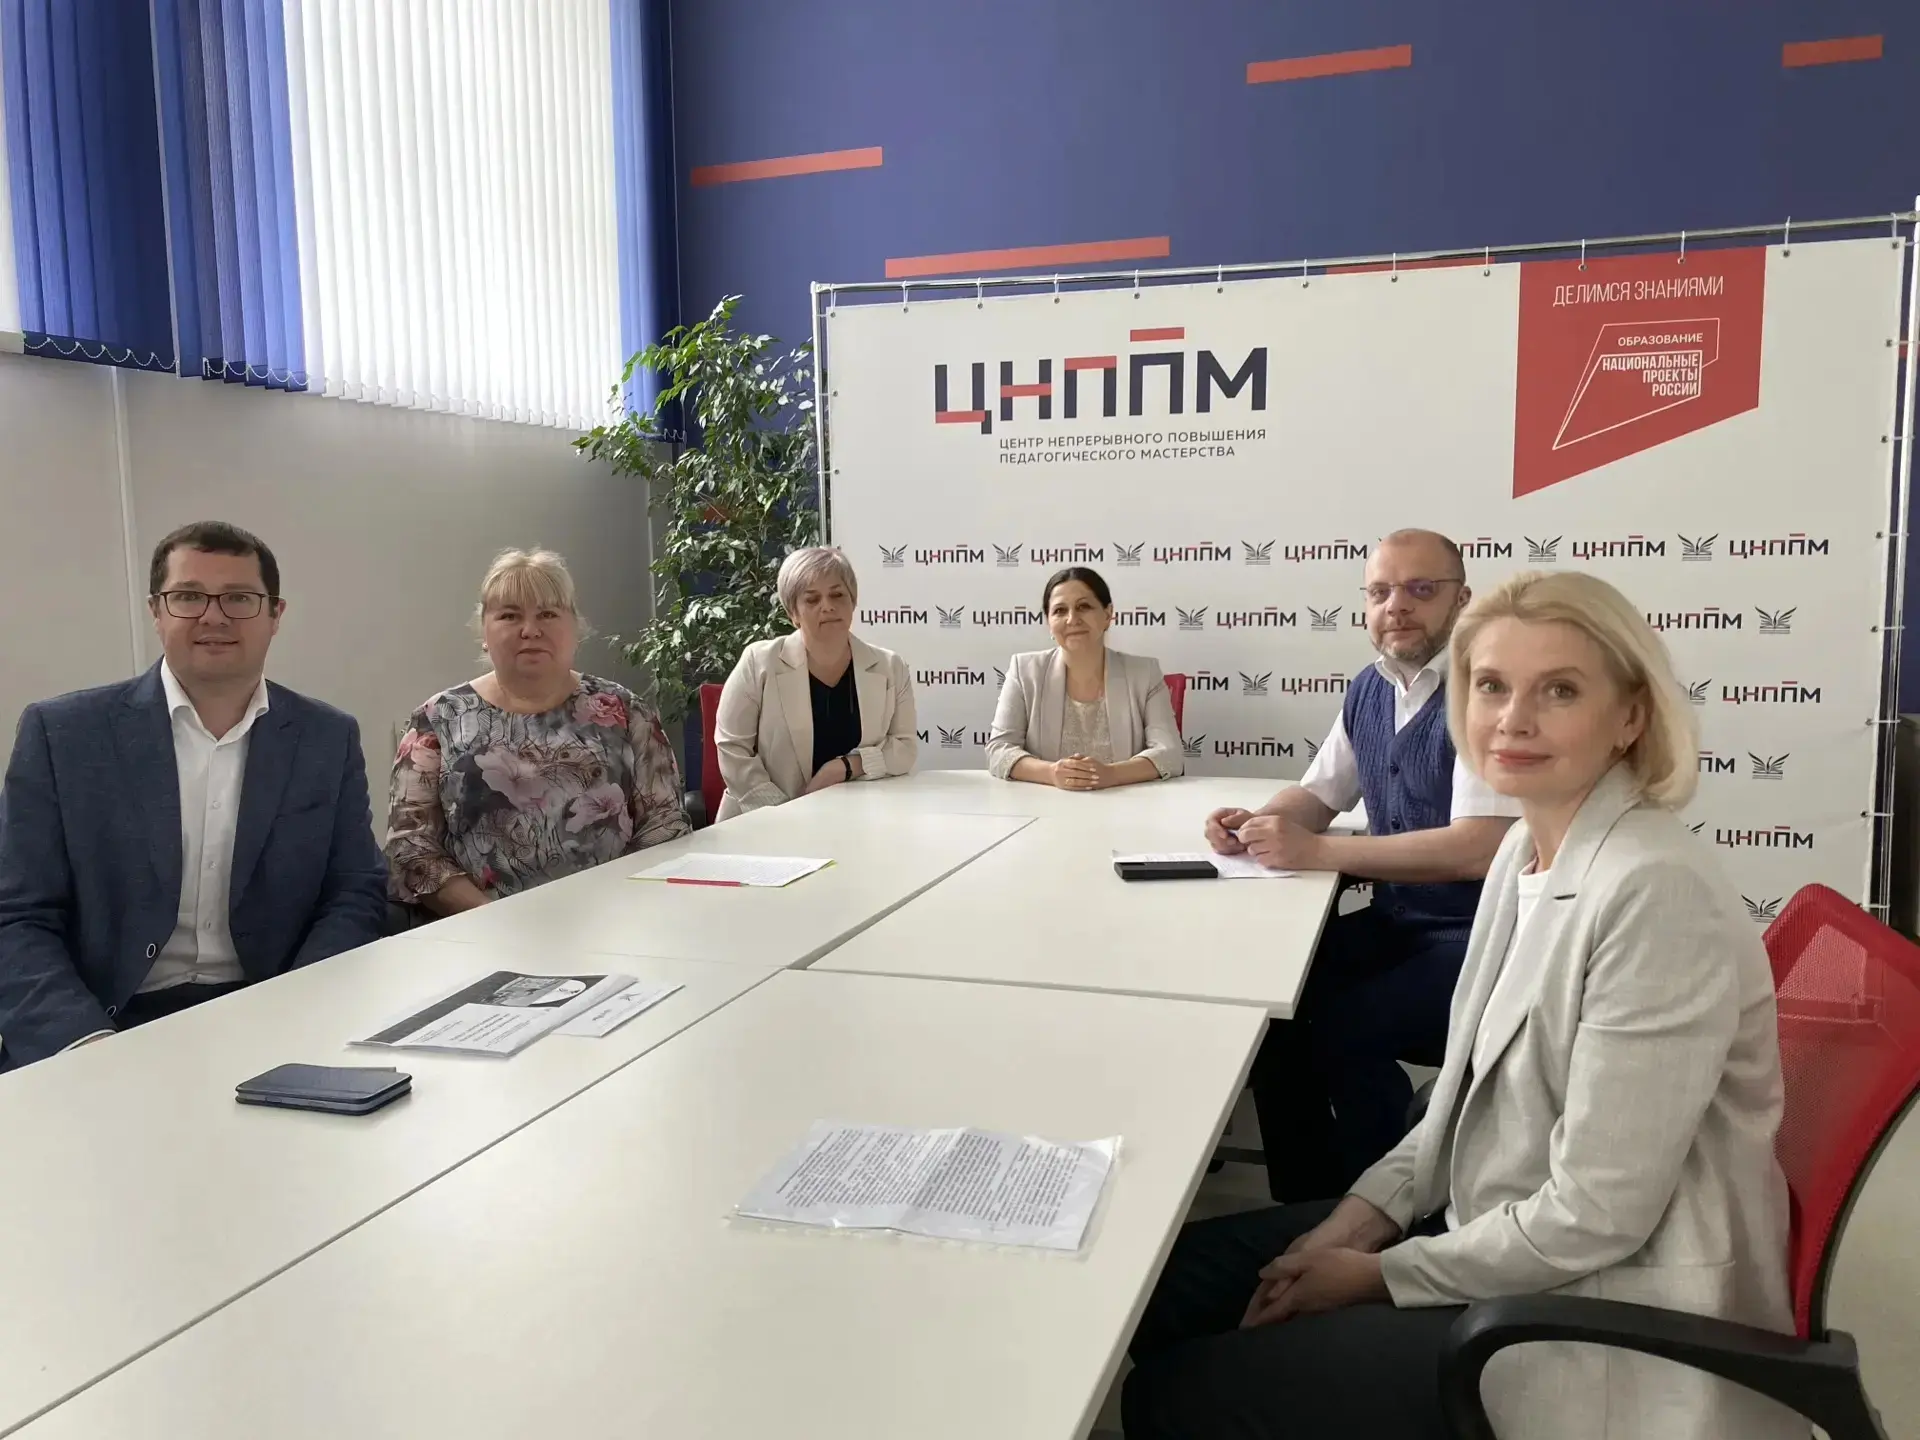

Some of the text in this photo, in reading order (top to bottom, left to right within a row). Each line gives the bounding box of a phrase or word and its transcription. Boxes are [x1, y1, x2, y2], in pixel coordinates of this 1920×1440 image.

[1553, 275, 1724, 307] ДЕЛИМСЯ ЗНАНИЯМИ
[1617, 333, 1704, 347] ОБРАЗОВАНИЕ
[1602, 353, 1699, 371] НАЦИОНАЛЬНЫЕ
[935, 327, 1267, 435] ЦНППМ
[1642, 368, 1698, 383] ПРОЕКТЫ
[1652, 382, 1698, 397] РОССИИ
[1000, 429, 1267, 450] ЦЕНТР НЕПРЕРЫВНОГО ПОВЫШЕНИЯ
[1000, 446, 1236, 464] ПЕДАГОГИЧЕСКОГО МАСТЕРСТВА
[915, 544, 984, 565] ЦНППМ
[1031, 543, 1104, 565] ЦНППМ
[1153, 541, 1231, 564] ЦНППМ
[1284, 539, 1368, 563] ЦНППМ
[1456, 537, 1512, 558] ППМ
[1572, 535, 1666, 560] ЦНППМ
[1729, 533, 1829, 559] ЦНППМ
[860, 606, 928, 626] ЦНППМ
[973, 606, 1043, 627] ЦНППМ
[1110, 606, 1166, 626] НППМ
[1216, 607, 1297, 629] ЦНППМ
[1647, 607, 1742, 632] ЦНППМ
[917, 666, 985, 686] ЦНППМ
[1281, 673, 1352, 695] ЦНПП
[1722, 681, 1821, 705] ЦНППМ
[1214, 736, 1294, 757] ЦНППМ
[1716, 826, 1813, 849] ЦНППМ
